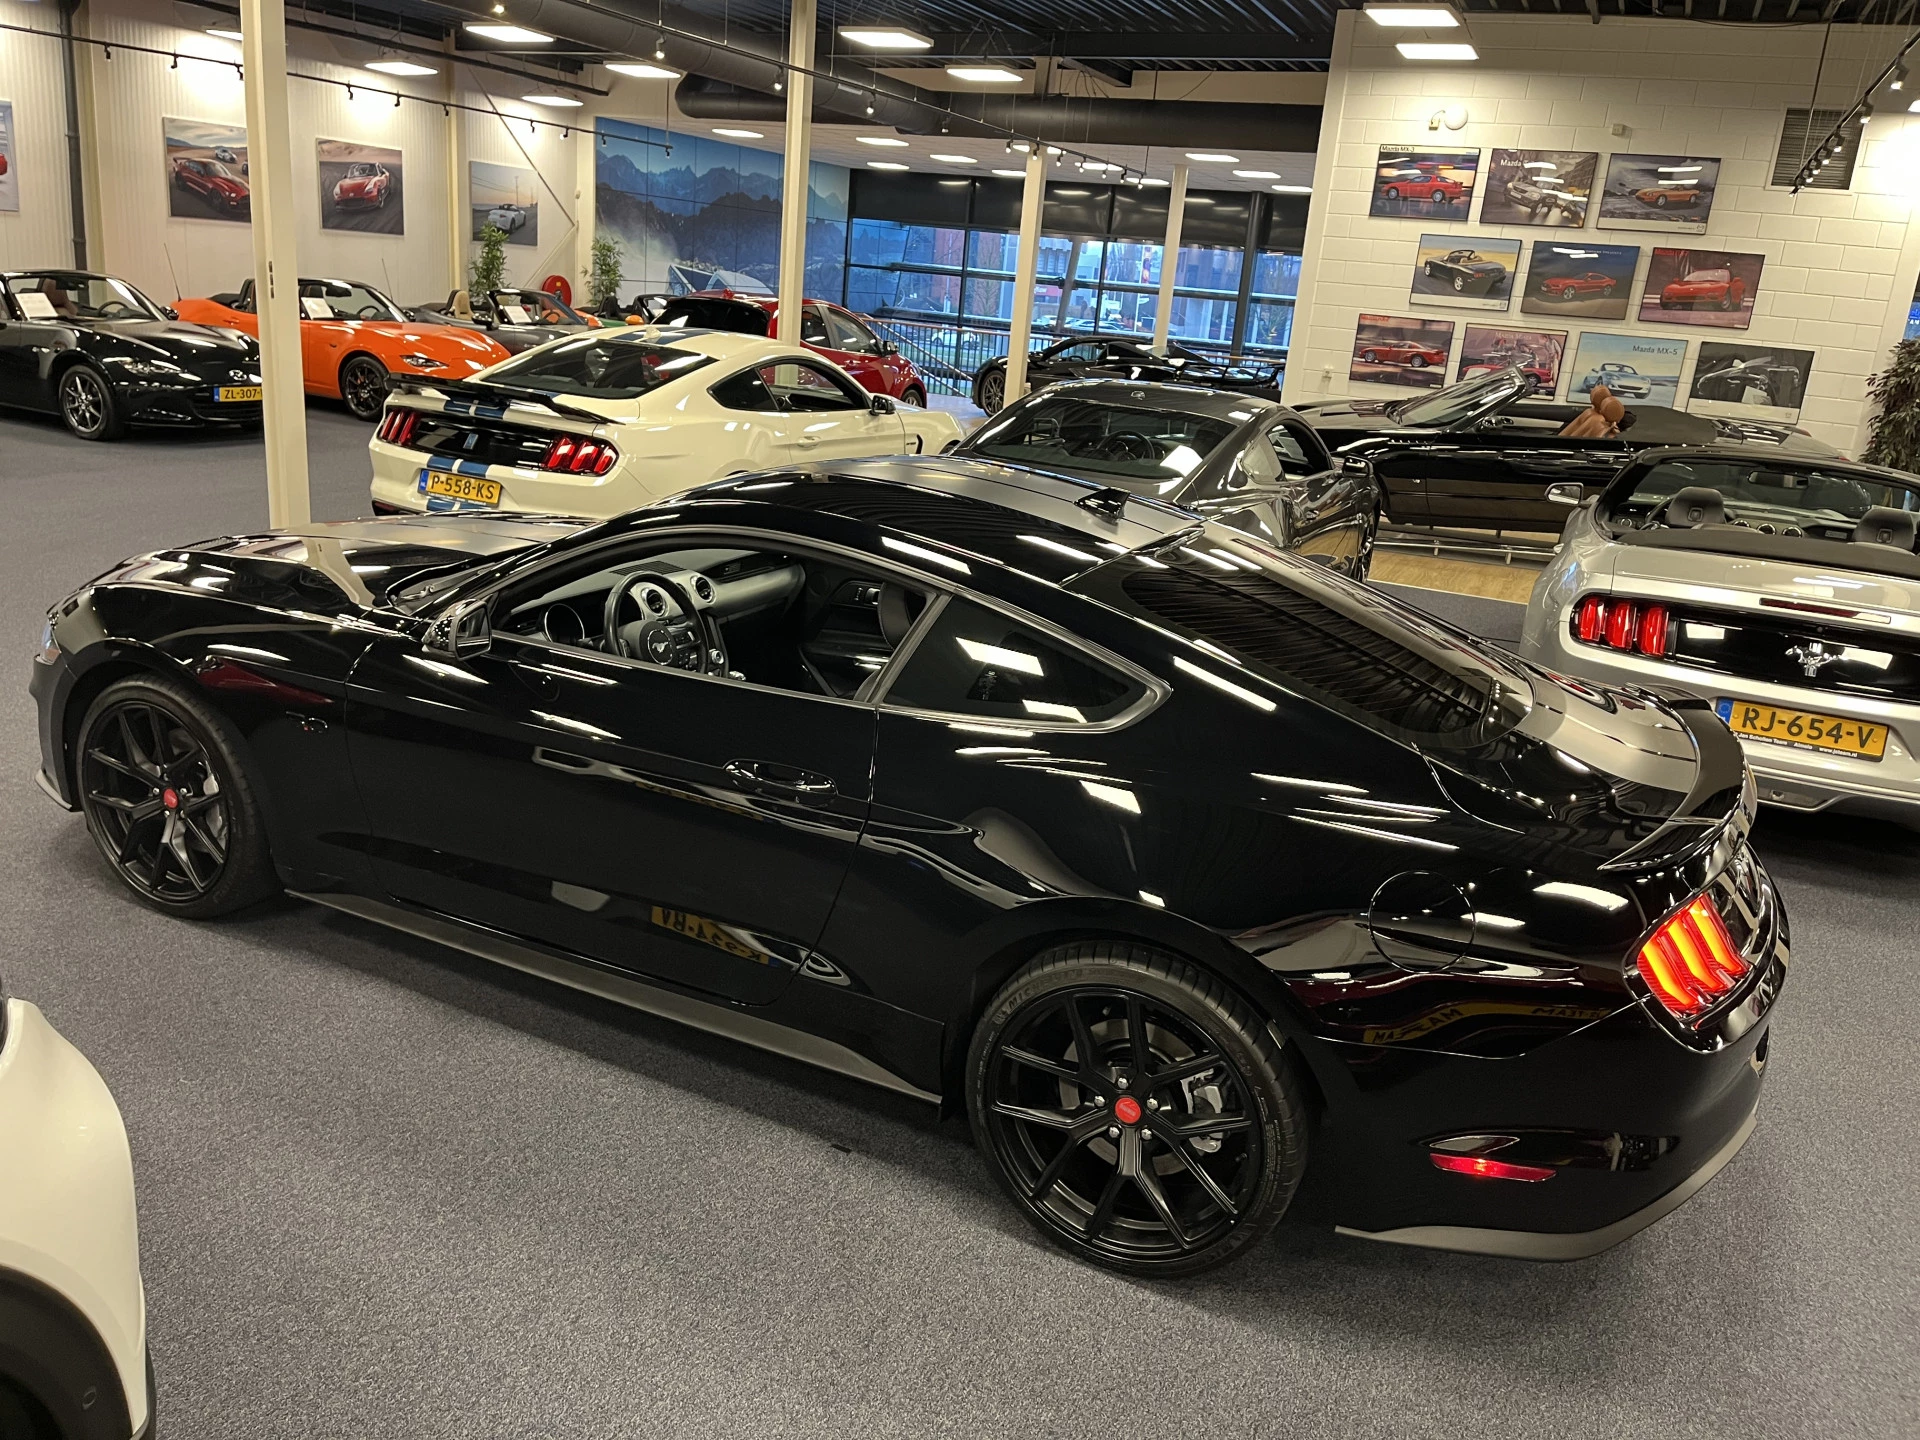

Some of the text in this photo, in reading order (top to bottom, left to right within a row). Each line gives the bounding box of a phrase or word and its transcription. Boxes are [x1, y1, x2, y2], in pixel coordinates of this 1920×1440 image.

[1632, 345, 1678, 355] Mazda MX-5
[224, 388, 263, 399] ZL-307-
[431, 474, 495, 500] P-558-KS
[1741, 707, 1875, 749] RJ-654-V
